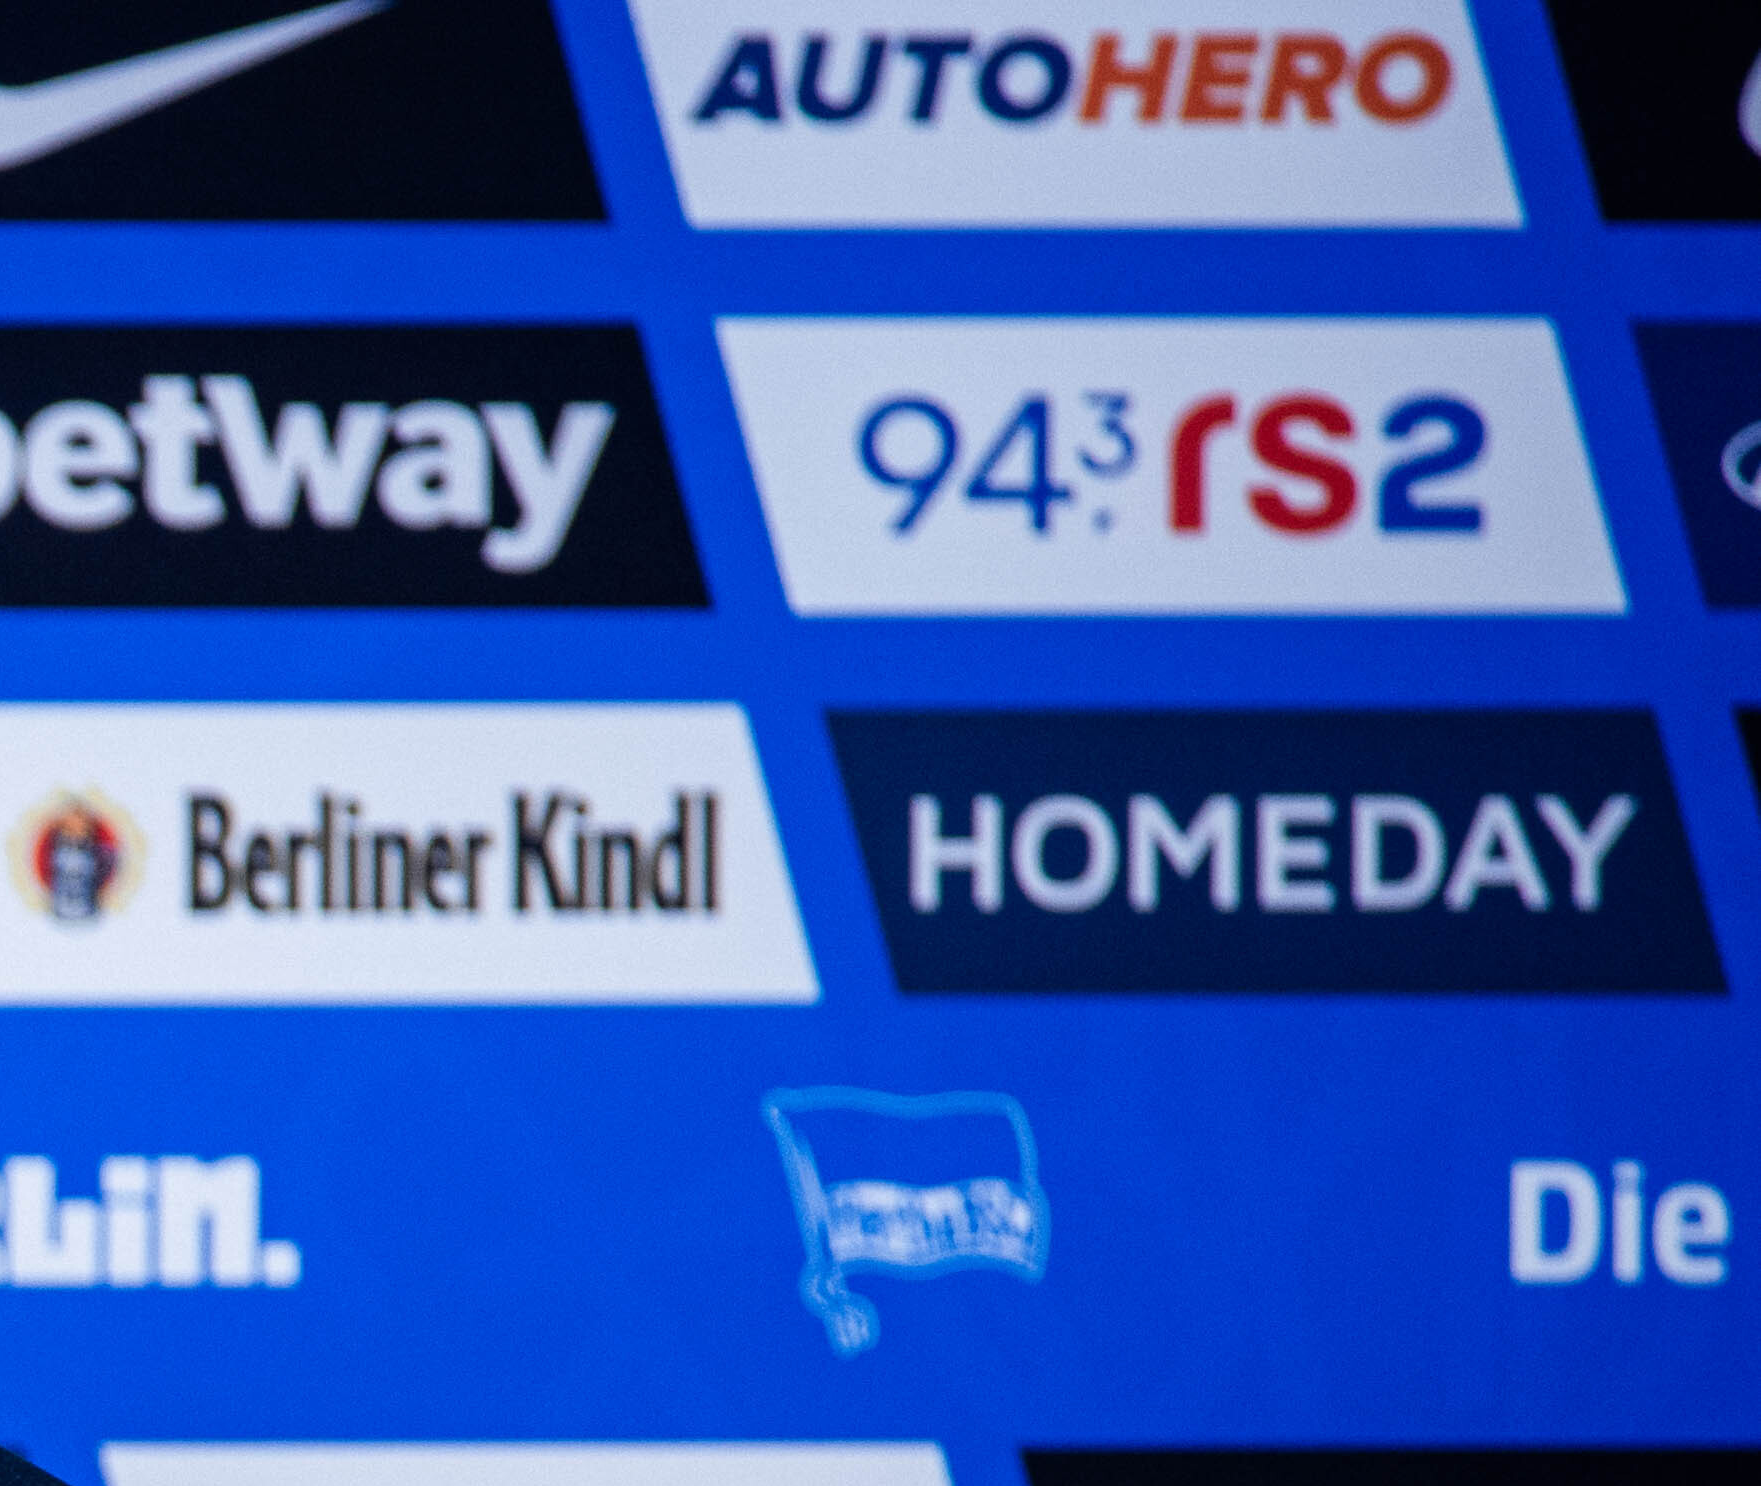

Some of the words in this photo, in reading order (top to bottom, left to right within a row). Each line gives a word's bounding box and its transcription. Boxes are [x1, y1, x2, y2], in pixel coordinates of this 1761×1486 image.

[691, 33, 1454, 124] AUTOHERO
[1168, 390, 1489, 537] rs2
[182, 785, 493, 916] Berliner
[509, 785, 721, 916] Kindl
[909, 794, 1637, 913] HOMEDAY
[1509, 1159, 1733, 1286] Die
